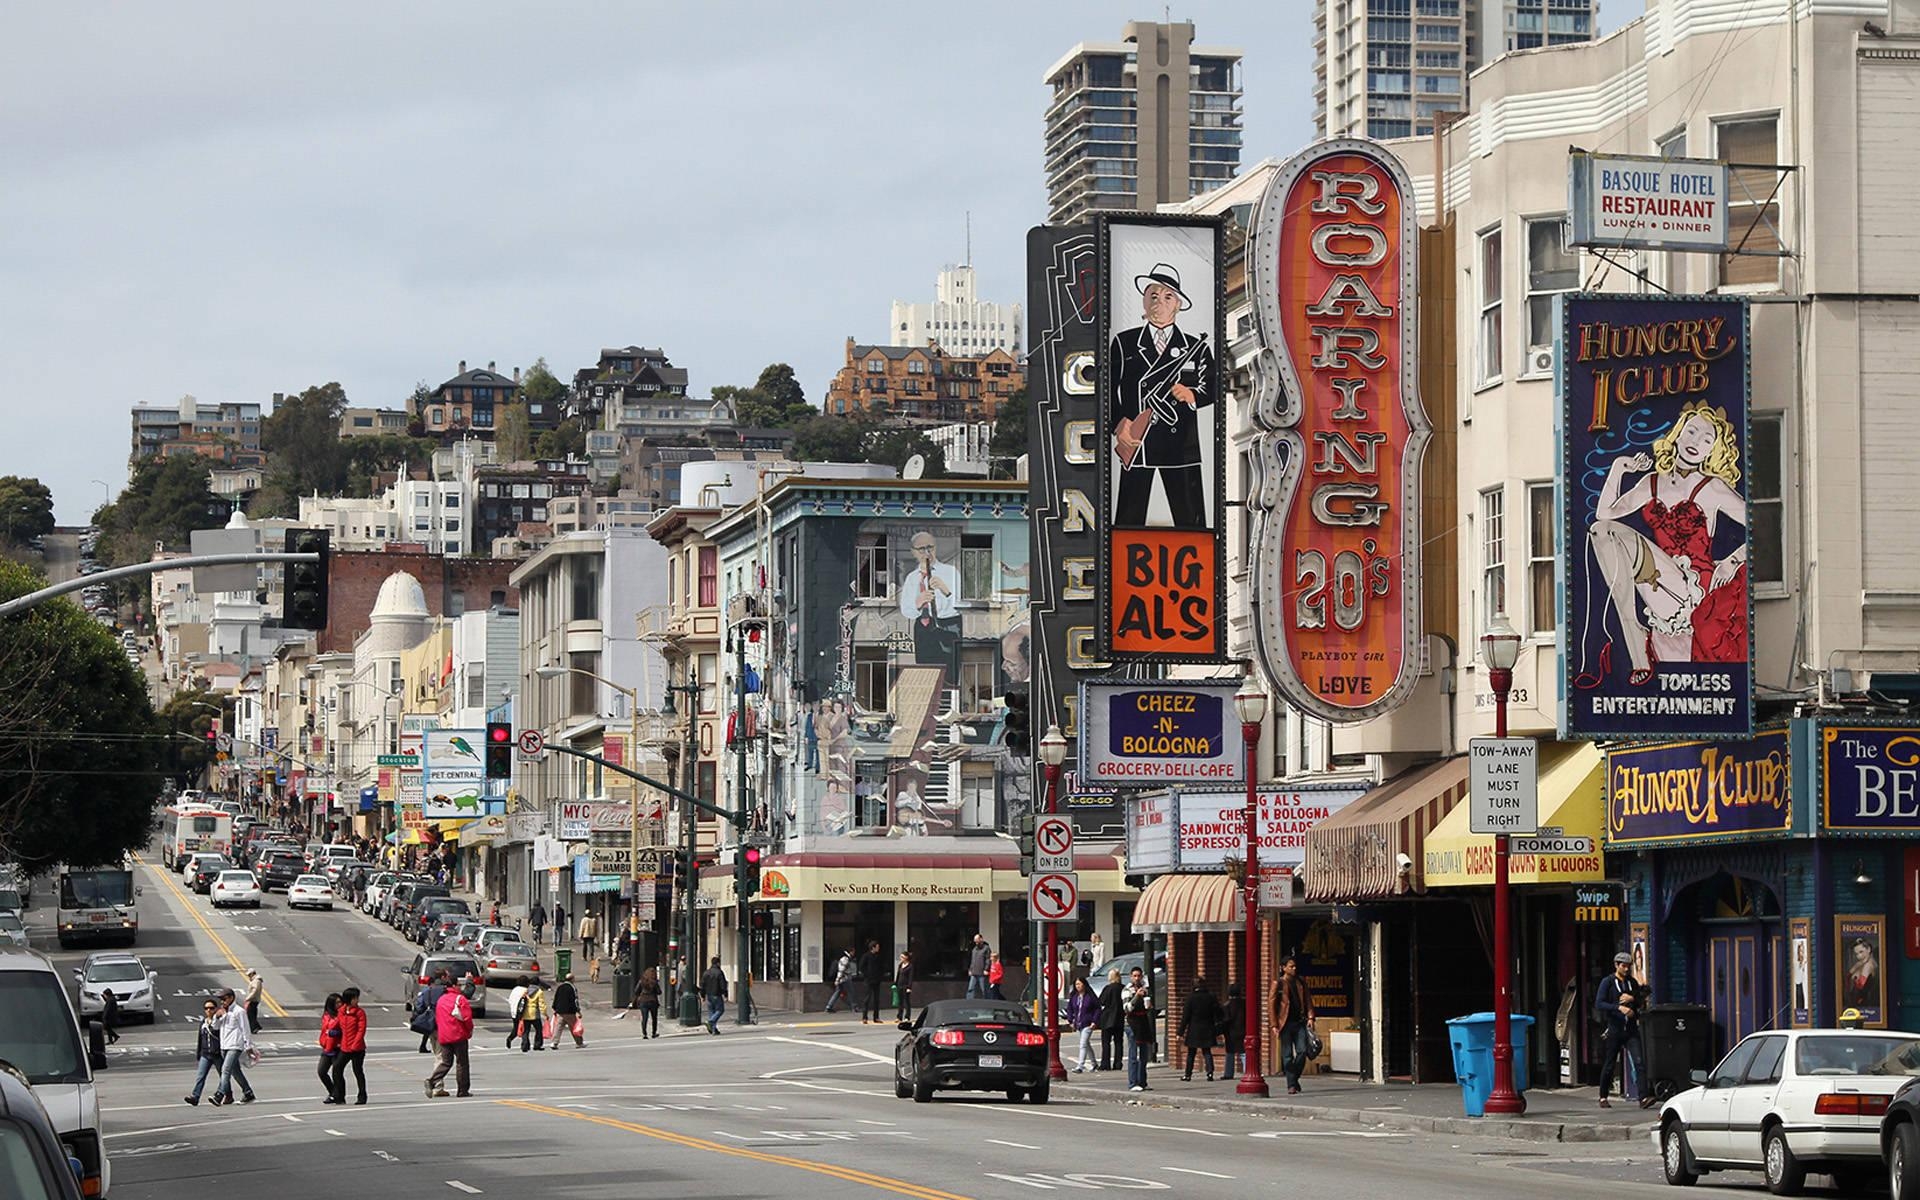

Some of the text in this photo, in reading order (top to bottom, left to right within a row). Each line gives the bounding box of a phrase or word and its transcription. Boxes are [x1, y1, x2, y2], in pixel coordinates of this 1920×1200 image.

[1602, 170, 1716, 196] BASQUE HOTEL
[1602, 195, 1716, 219] RESTAURANT
[1603, 218, 1712, 233] LUNCH DINNER
[1577, 315, 1738, 363] HUNGRY
[1306, 170, 1394, 528] ROARING
[1615, 360, 1711, 407] CLUB
[1125, 543, 1204, 590] BIG
[1117, 589, 1210, 641] AL'S
[1301, 651, 1385, 662] PLAYBOY GIRL
[1319, 675, 1373, 695] LOVE
[1657, 673, 1732, 692] TOPLESS
[1136, 694, 1197, 713] CHEEZ
[1592, 697, 1737, 716] ENTERTAINMENT
[1122, 736, 1210, 755] BOLOGNA
[1472, 746, 1534, 757] TOW-AWAY
[1841, 739, 1878, 759] The
[380, 756, 418, 764] Stockton
[431, 771, 481, 779] PET CENTRAL
[1097, 762, 1235, 777] GROCERY-DELI-CAFE
[1487, 763, 1520, 774] LANE
[1487, 780, 1520, 791] MUST
[1613, 763, 1703, 831] HUNGRY
[1718, 751, 1786, 809] CLUB
[1854, 764, 1920, 817] BE
[1488, 797, 1521, 809] TURN
[563, 804, 580, 819] MY
[1261, 808, 1269, 820] N
[1273, 807, 1329, 820] BOLOGNA
[1487, 814, 1521, 826] RIGHT
[1180, 836, 1240, 850] ESPRESSO
[1517, 839, 1585, 851] ROMOLO
[616, 850, 659, 863] PIZA
[1040, 857, 1070, 867] ON RED
[1425, 851, 1463, 875] BROADWAY
[1465, 845, 1493, 876] CIGARS
[602, 863, 657, 873] HAMBUGERS
[1539, 856, 1600, 873] & LIQUORS
[823, 883, 984, 897] New Sun Hong Kong Restaurant
[1268, 892, 1285, 900] TIME
[1576, 888, 1610, 906] Swipe
[1575, 906, 1620, 922] ATM
[1842, 923, 1872, 934] HUNGRY
